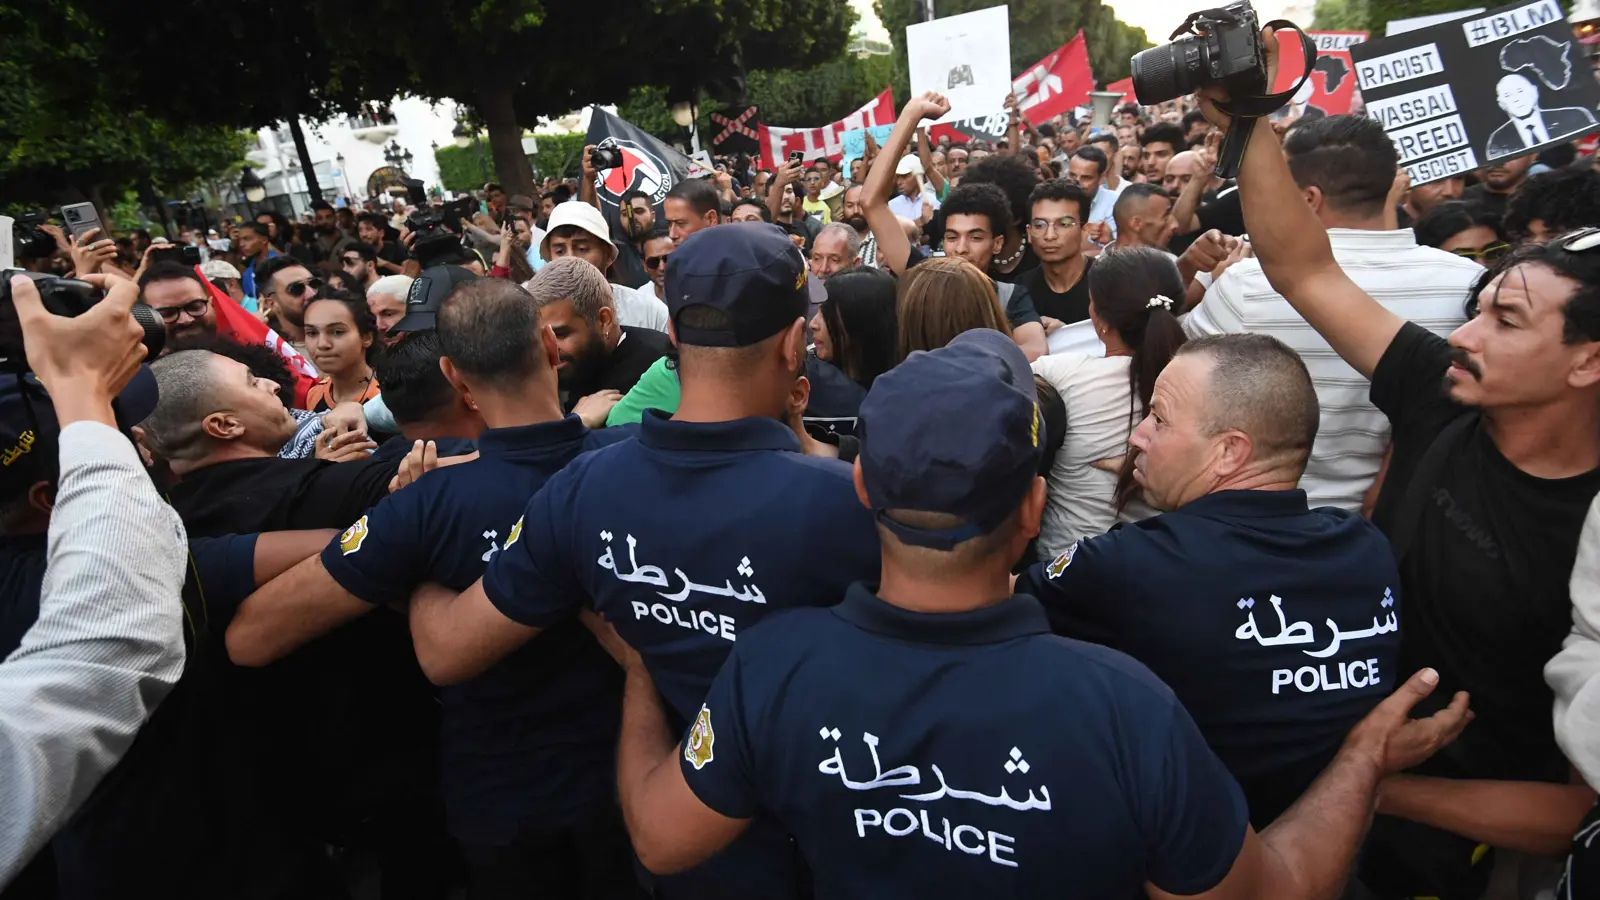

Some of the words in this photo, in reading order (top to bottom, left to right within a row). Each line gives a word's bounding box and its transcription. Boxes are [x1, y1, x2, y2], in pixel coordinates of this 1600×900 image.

[1470, 3, 1554, 43] #BLM
[1361, 51, 1435, 86] RACIST
[1398, 122, 1463, 159] REED
[653, 173, 671, 202] ACTION
[1406, 152, 1468, 183] ASCIST
[597, 529, 767, 604] شرطة
[631, 600, 736, 642] POLICE
[1235, 586, 1398, 658] شرطة
[1272, 658, 1381, 694] POLICE
[818, 726, 1052, 811] شرطة
[854, 807, 1019, 868] POLICE
